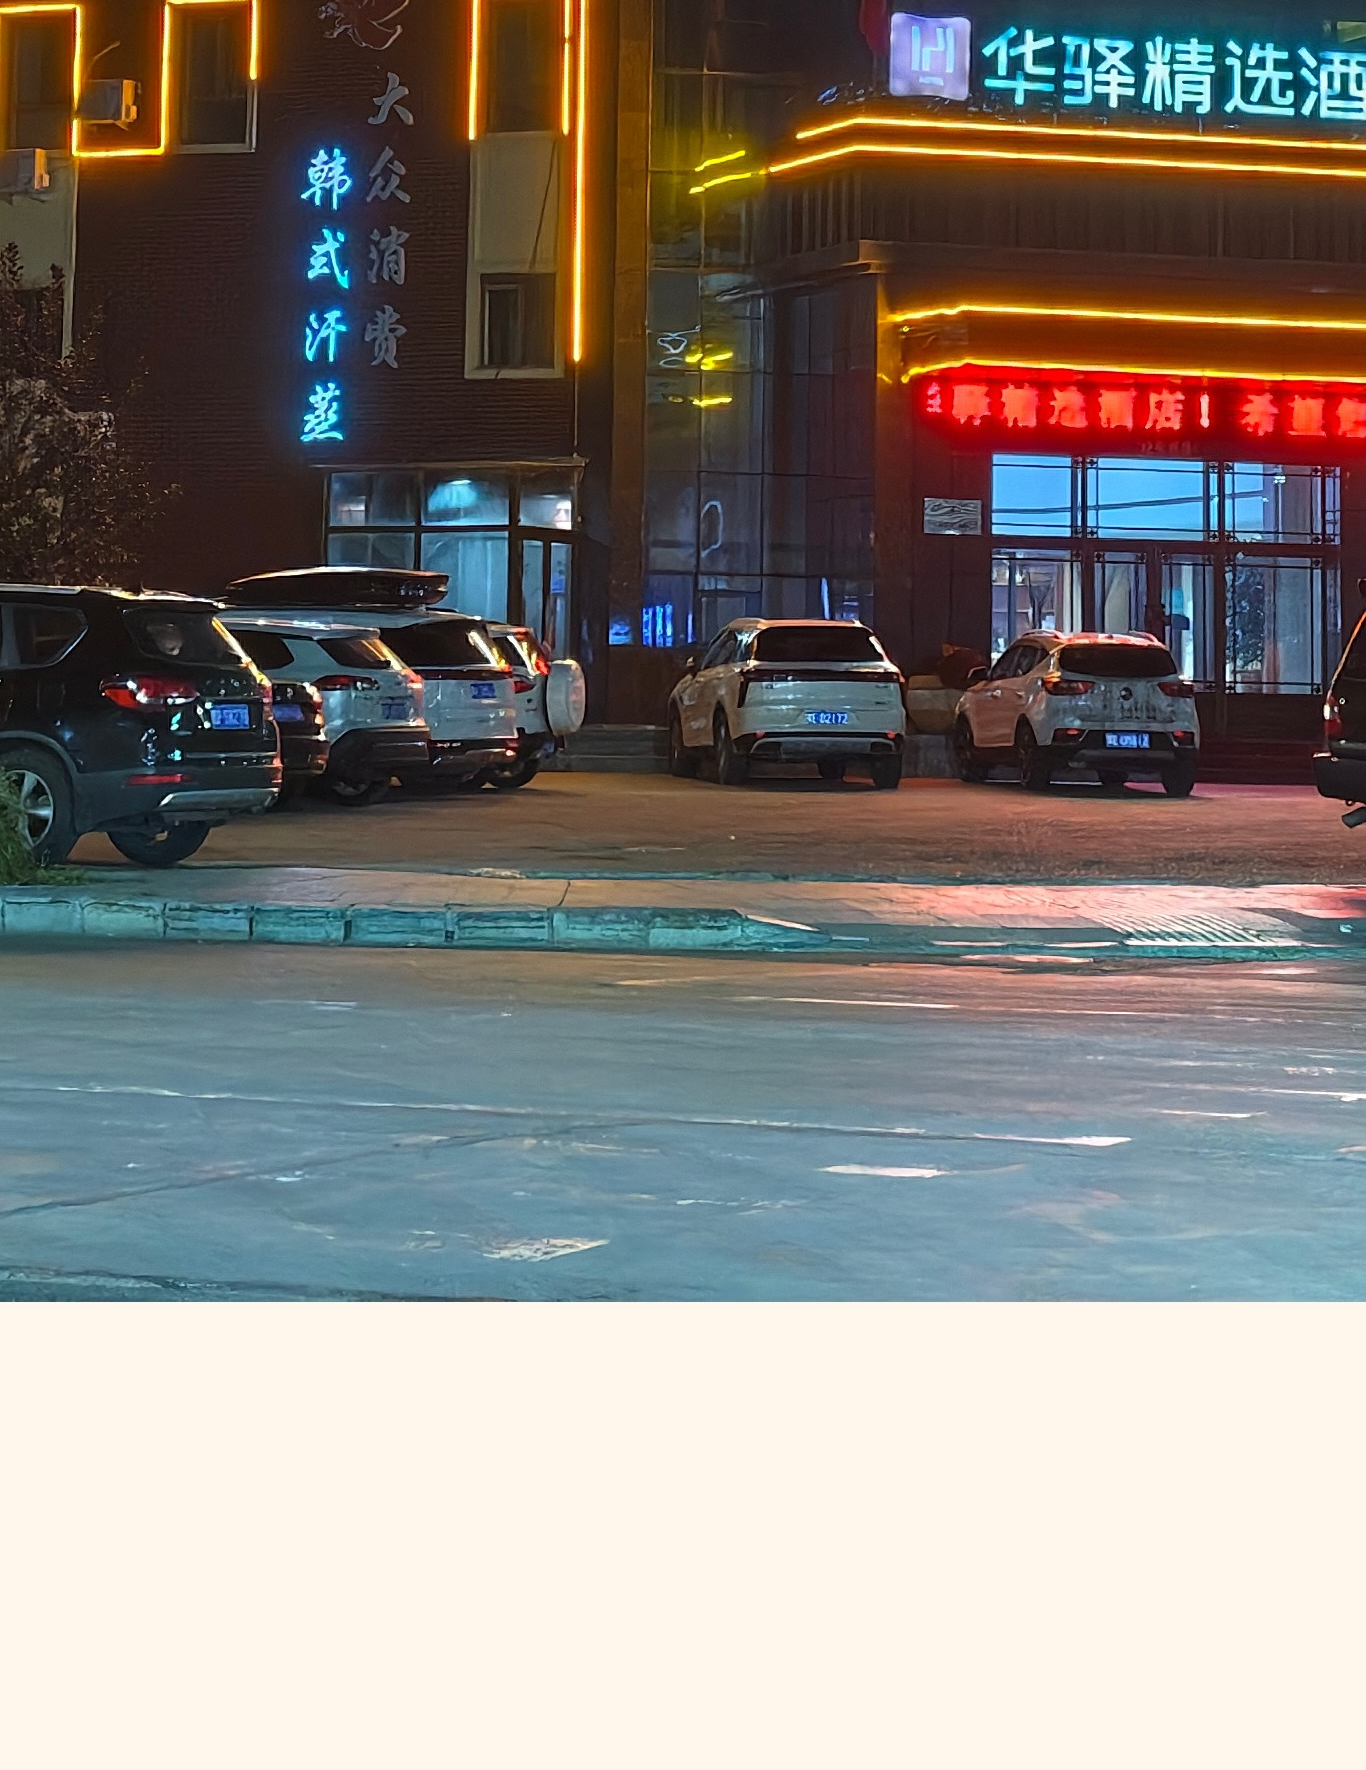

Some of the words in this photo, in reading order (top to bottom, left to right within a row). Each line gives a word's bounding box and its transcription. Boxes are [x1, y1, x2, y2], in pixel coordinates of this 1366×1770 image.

[300, 147, 354, 443] 韩式汗蒸
[364, 72, 415, 369] 大众消费
